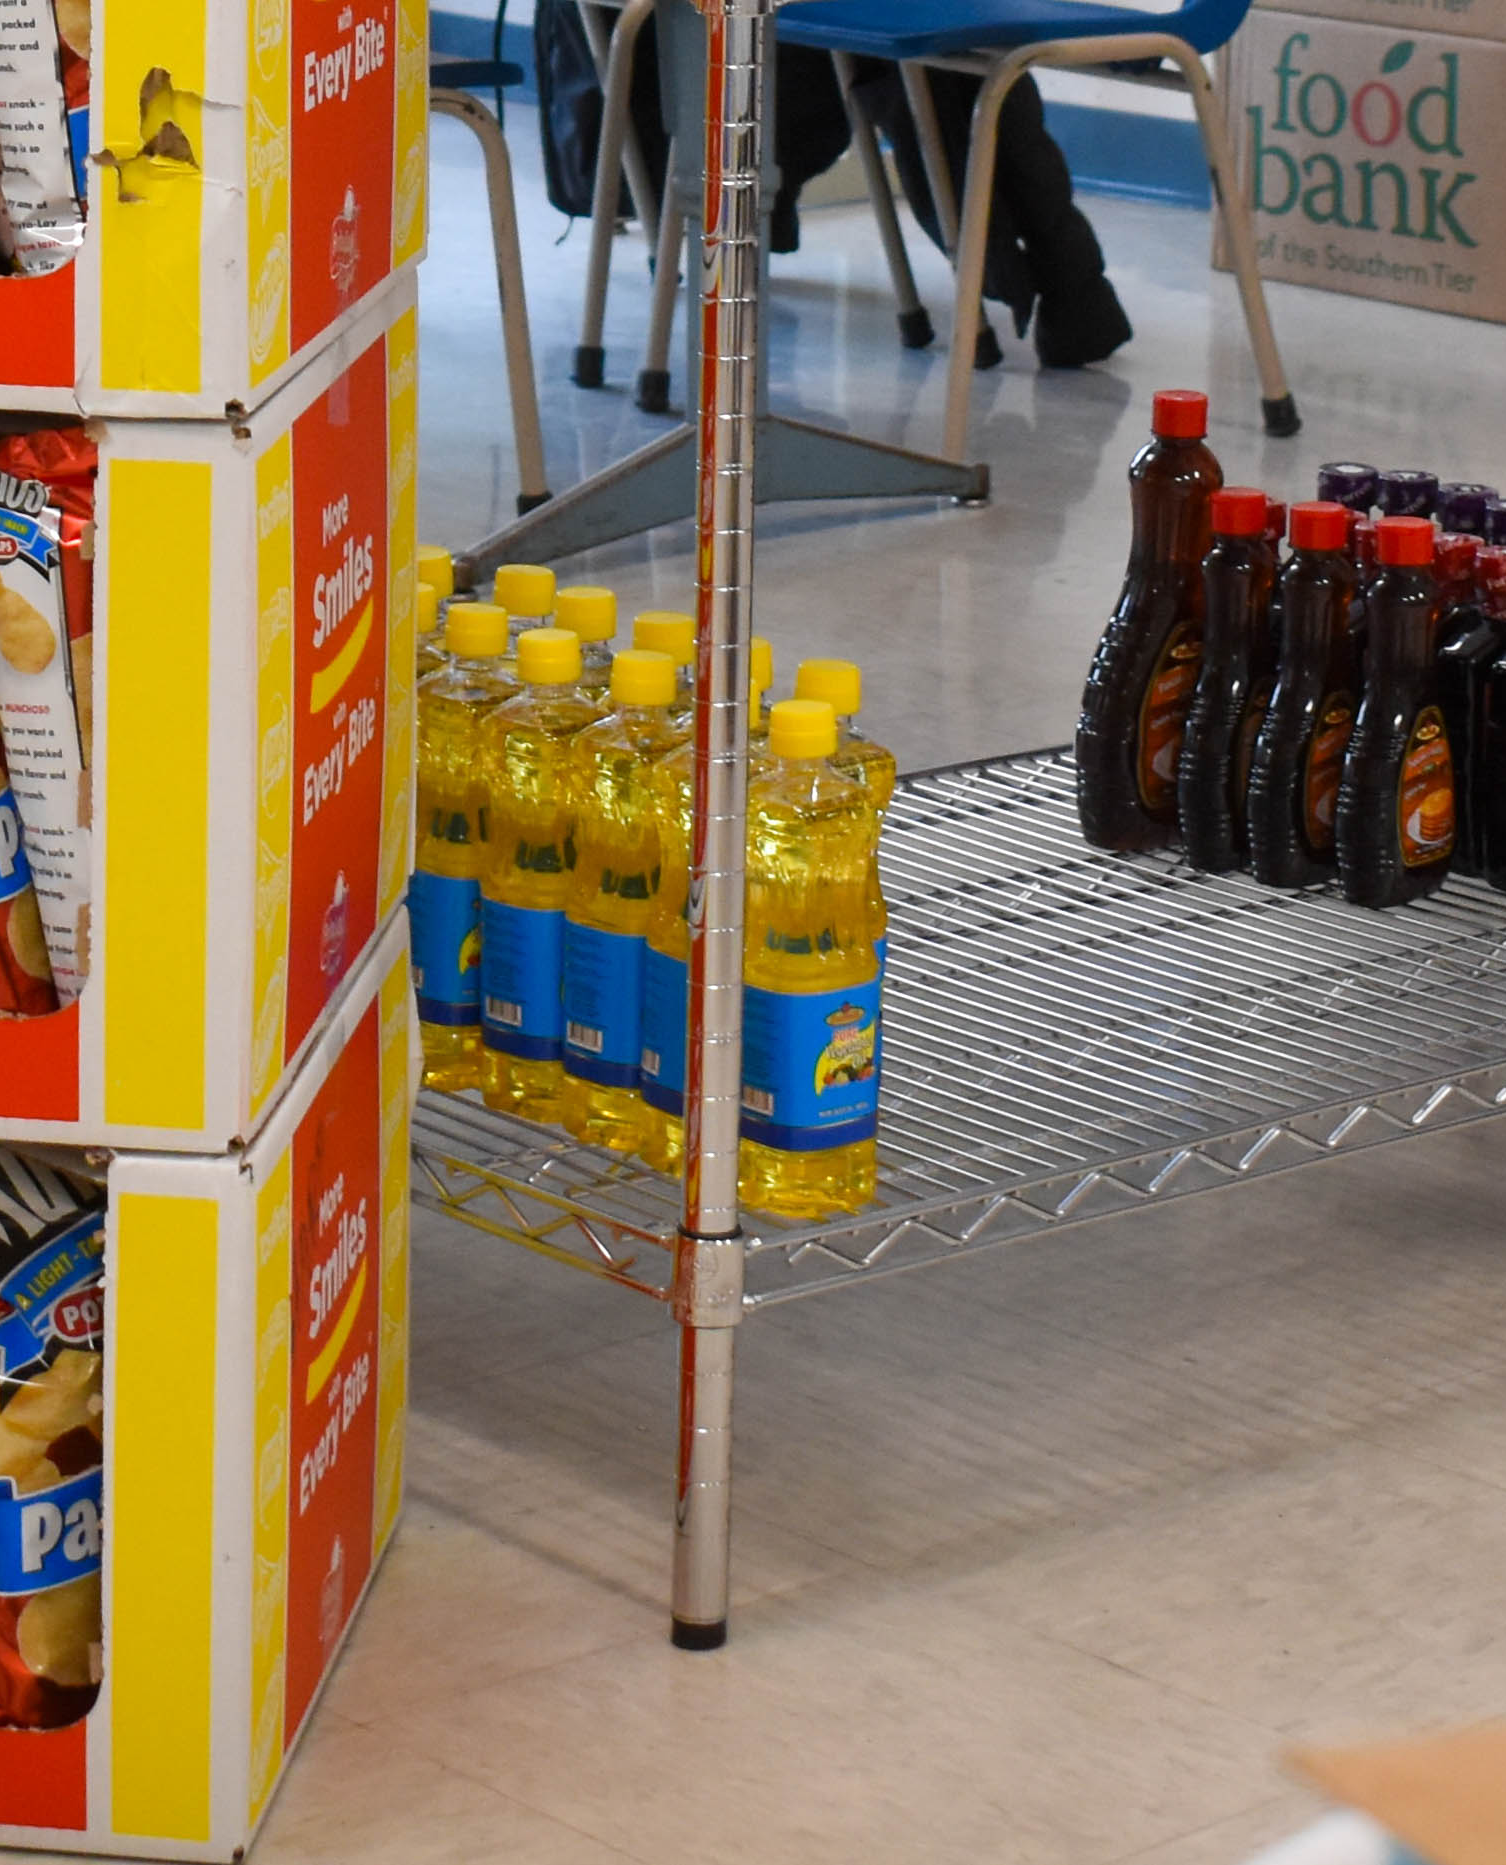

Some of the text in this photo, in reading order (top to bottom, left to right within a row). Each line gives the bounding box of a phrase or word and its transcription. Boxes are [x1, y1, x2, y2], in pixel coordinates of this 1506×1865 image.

[1, 17, 36, 30] packed
[19, 40, 40, 51] and
[305, 38, 351, 113] Every
[1272, 34, 1464, 157] food
[1247, 106, 1478, 250] bank
[322, 494, 348, 542] More
[313, 532, 374, 648] Smiles
[303, 737, 346, 825] Every
[308, 1208, 367, 1338] Smiles
[299, 1413, 339, 1516] Every
